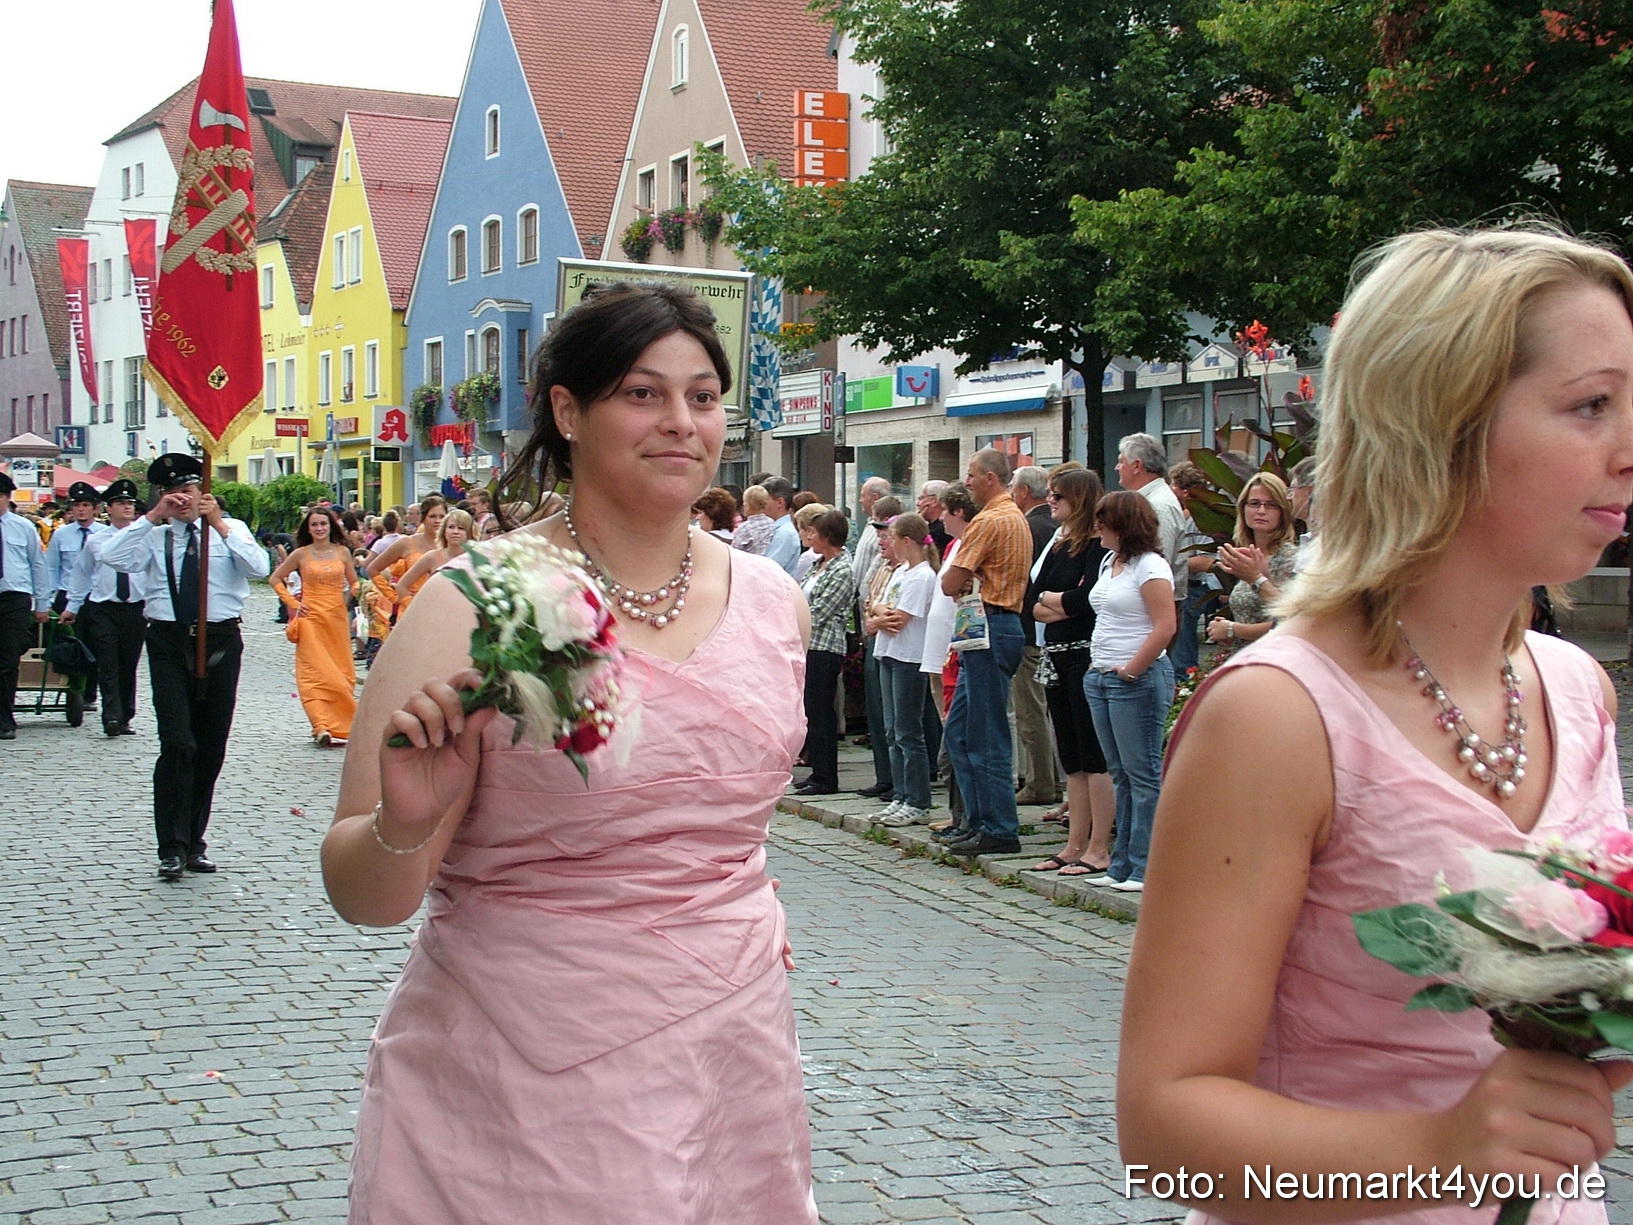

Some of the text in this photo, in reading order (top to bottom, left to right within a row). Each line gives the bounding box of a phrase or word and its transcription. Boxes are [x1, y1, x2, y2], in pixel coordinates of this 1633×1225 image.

[803, 91, 827, 186] ELE
[693, 284, 744, 302] erwehr
[165, 324, 197, 358] 1962
[262, 332, 275, 353] TEL
[823, 372, 832, 430] KINO
